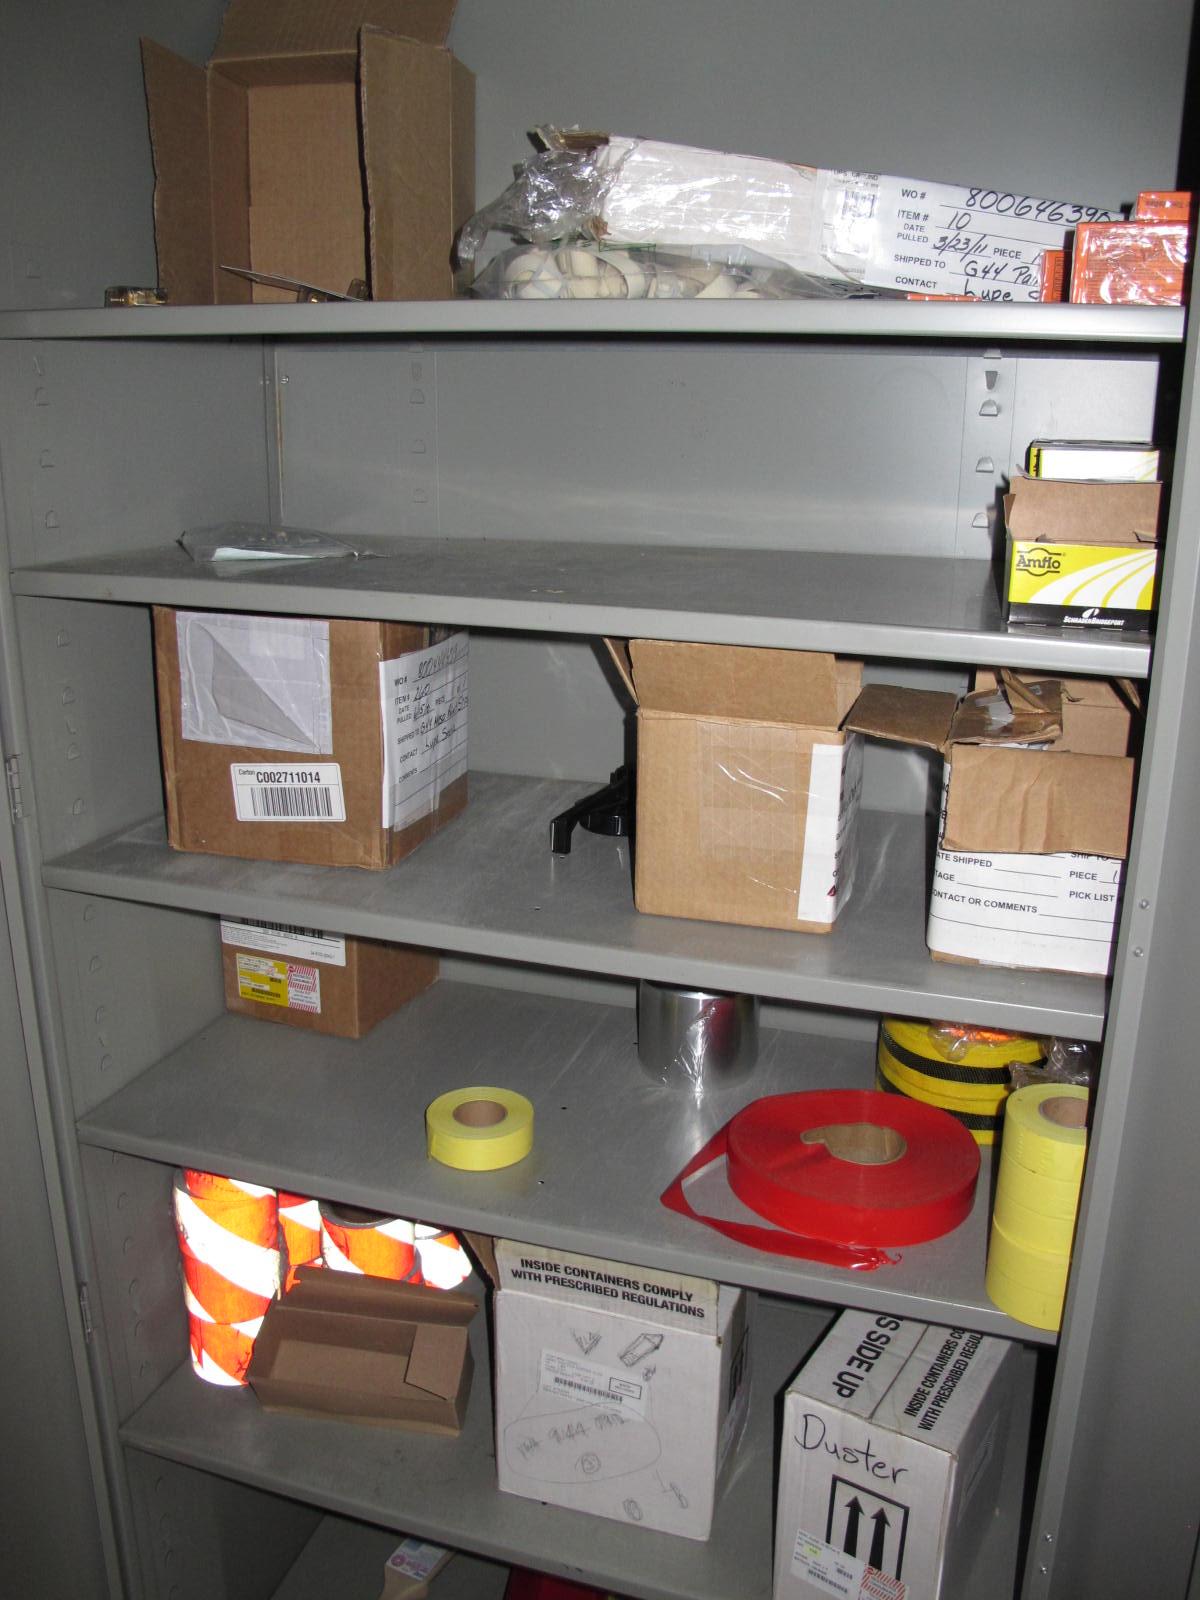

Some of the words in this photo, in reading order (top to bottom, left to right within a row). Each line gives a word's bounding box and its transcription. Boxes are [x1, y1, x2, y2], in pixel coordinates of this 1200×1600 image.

[901, 188, 918, 199] WO
[919, 191, 927, 199] #
[897, 209, 921, 221] ITEM
[922, 213, 929, 221] #
[948, 210, 972, 230] 10
[903, 222, 925, 233] DATE
[896, 232, 929, 243] PULLED
[894, 254, 932, 267] SHIPPED
[933, 260, 946, 268] TO
[993, 247, 1022, 260] PIECE
[964, 260, 1009, 280] G44
[895, 275, 938, 289] CONTACT
[1016, 555, 1061, 570] Amflo
[238, 768, 255, 776] Carton
[256, 771, 321, 784] C002711014
[935, 852, 951, 861] ATE
[952, 855, 993, 868] SHIPPED
[934, 869, 956, 882] TAGE
[1069, 870, 1098, 881] PIECE
[932, 888, 966, 903] ONTACT
[967, 897, 982, 906] OR
[983, 899, 1038, 914] COMMENTS
[1069, 890, 1092, 900] PICK
[1094, 893, 1115, 902] LIST
[520, 1258, 561, 1274] INSIDE
[564, 1265, 640, 1291] CONTAINERS
[643, 1282, 693, 1302] COMPLY
[511, 1268, 542, 1282] WITH
[544, 1274, 619, 1298] PRESCRIBED
[622, 1291, 705, 1318] REGULATIONS
[846, 1330, 892, 1373] SIDE
[832, 1370, 865, 1398] UP
[903, 1387, 931, 1418] INSIDE
[921, 1339, 959, 1389] CONTAINERS
[918, 1407, 942, 1431] WITH
[931, 1358, 969, 1409] PRESCRIBED
[794, 1413, 909, 1485] Duster
